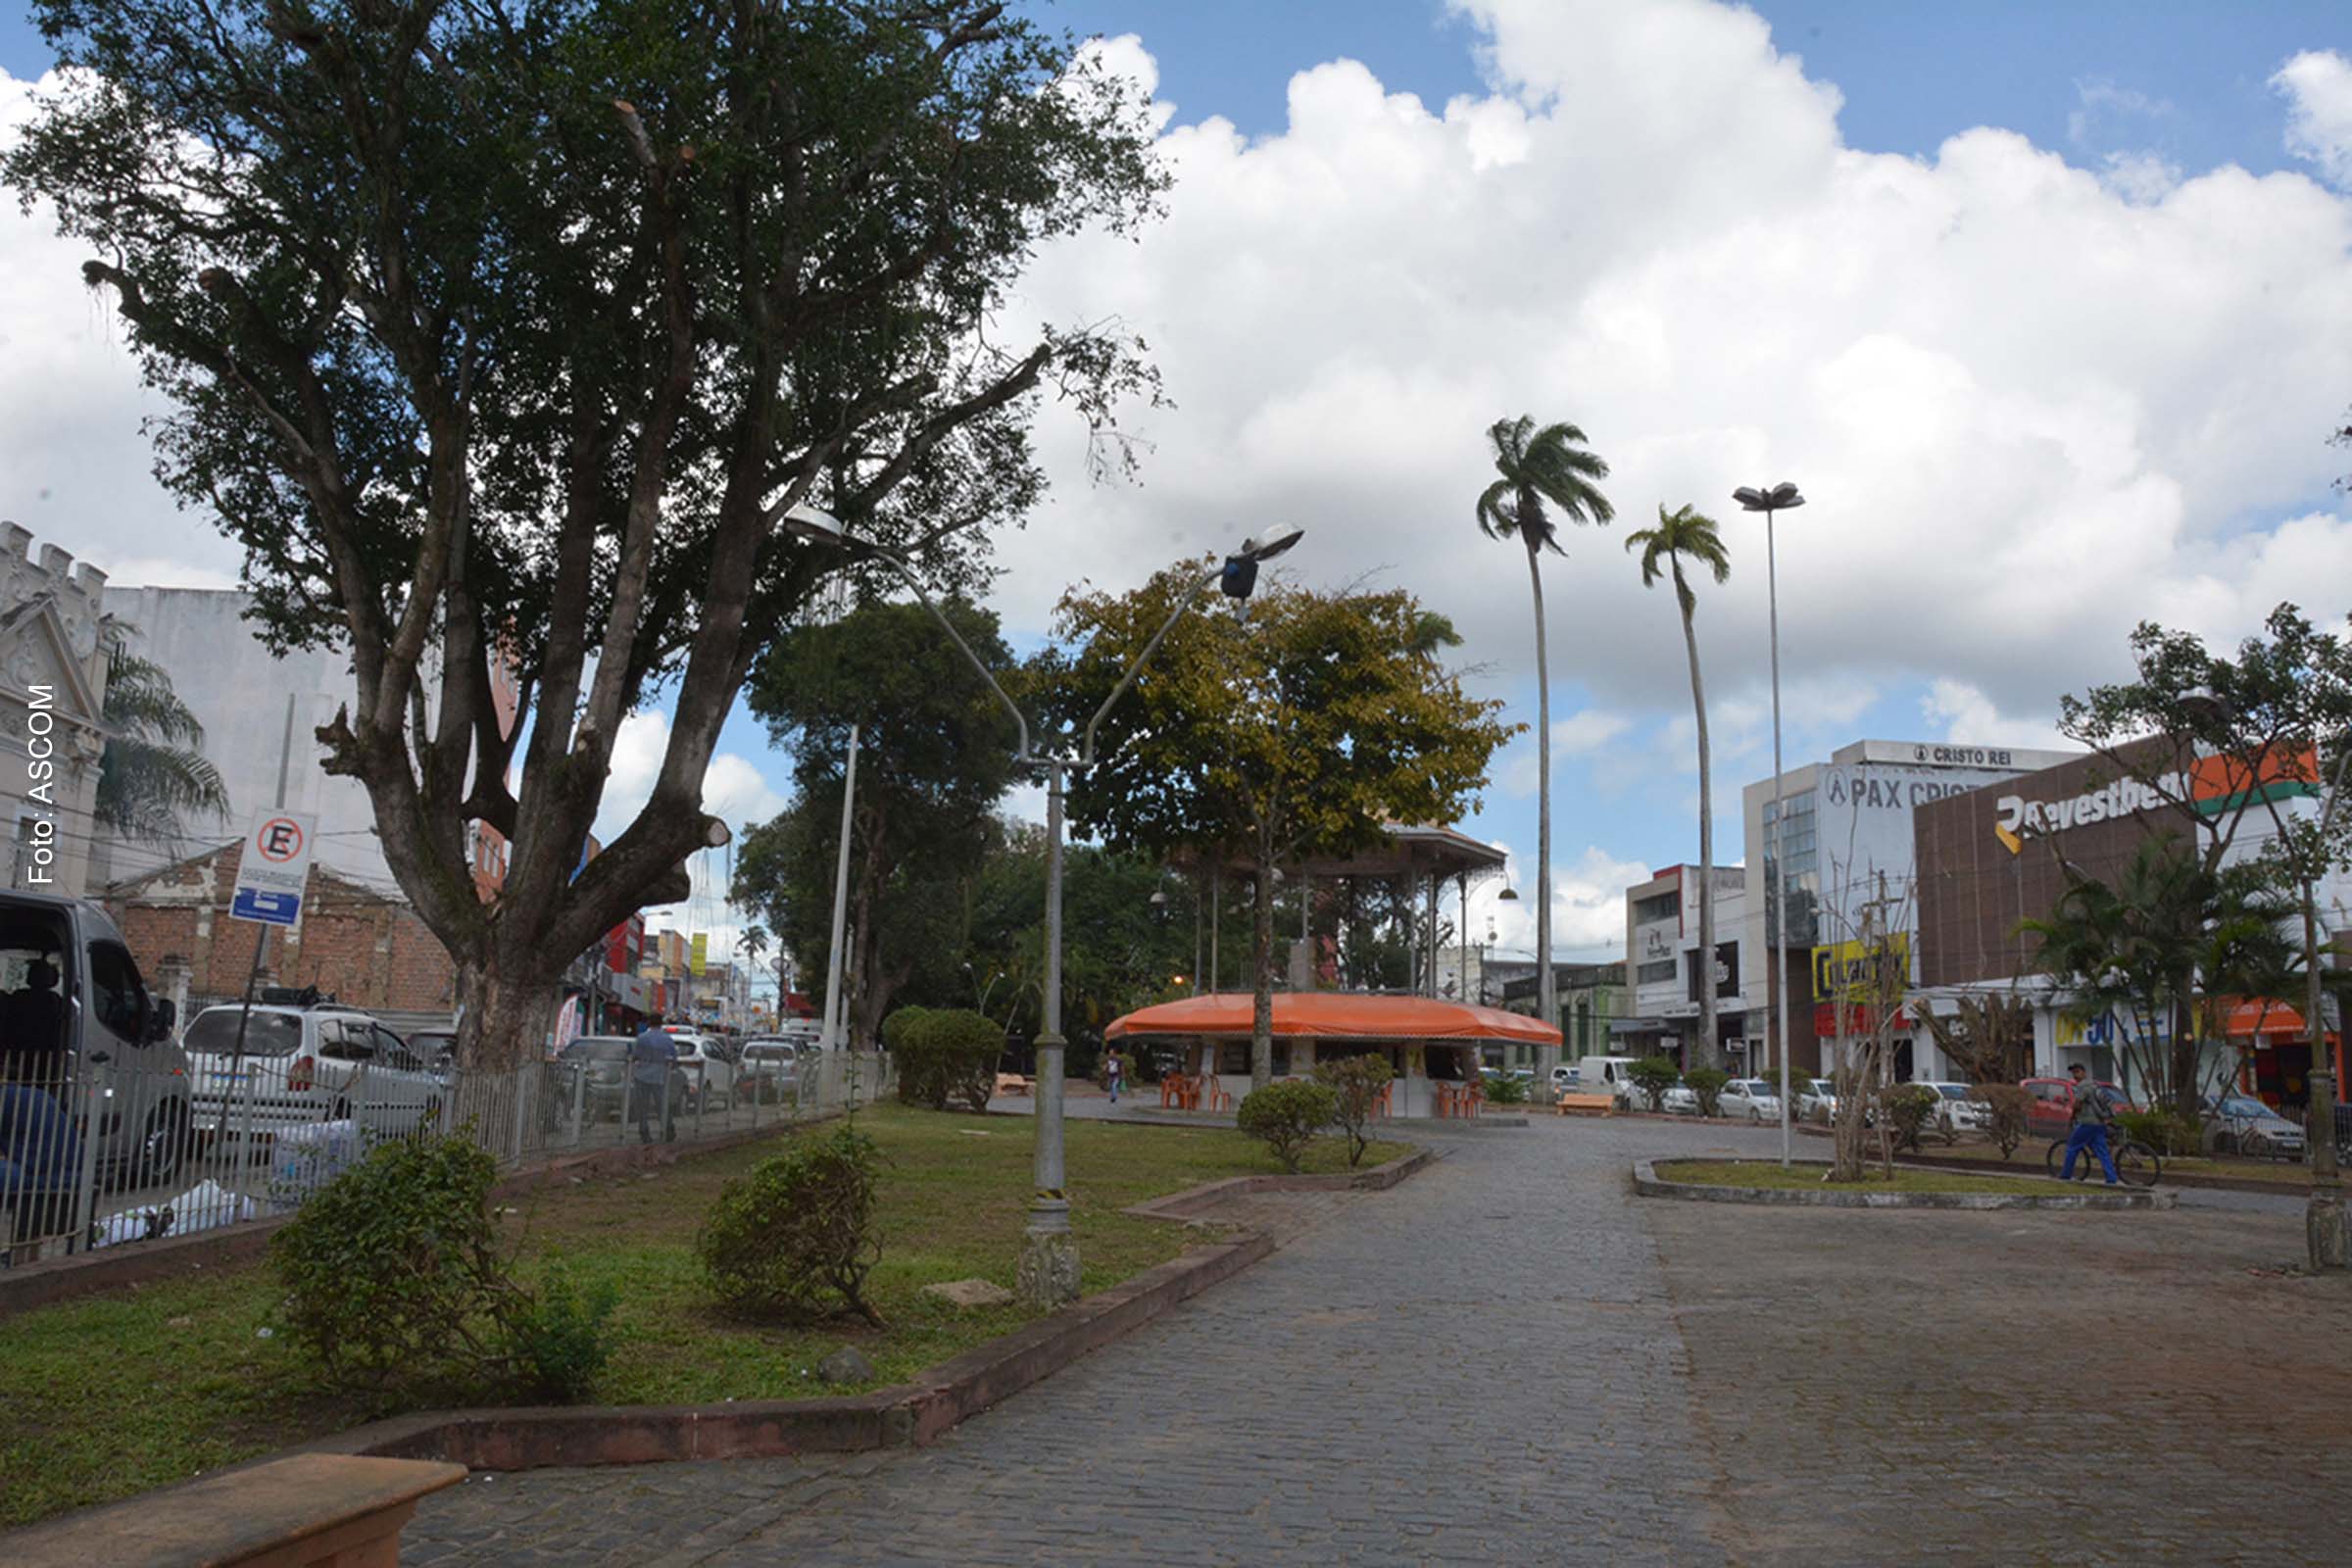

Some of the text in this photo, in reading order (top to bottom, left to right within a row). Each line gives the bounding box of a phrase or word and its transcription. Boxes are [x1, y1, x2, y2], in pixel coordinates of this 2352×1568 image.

[1934, 747, 2012, 766] CRISTO REI
[1851, 778, 1981, 808] PAX CRI
[269, 825, 294, 856] E
